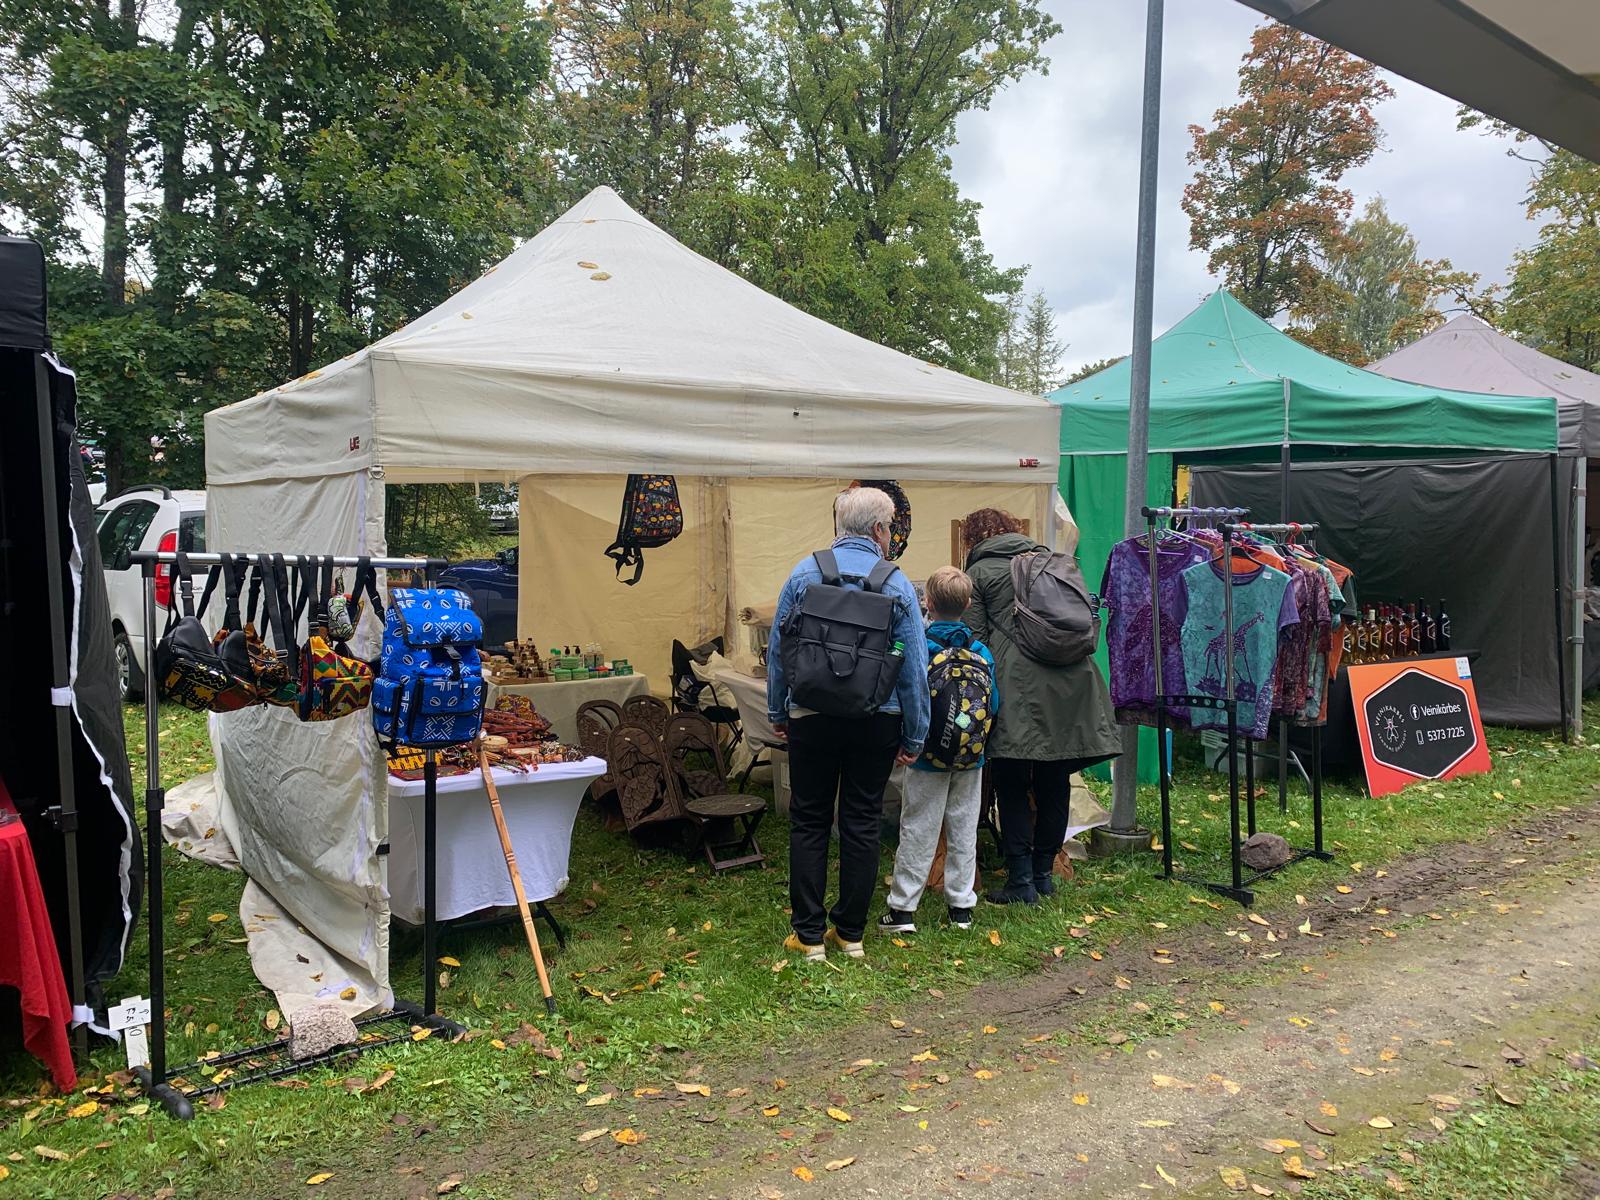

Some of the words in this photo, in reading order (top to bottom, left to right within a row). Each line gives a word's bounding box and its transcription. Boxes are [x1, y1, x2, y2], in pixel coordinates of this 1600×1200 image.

[940, 695, 957, 749] EXPLORE
[1427, 729, 1446, 741] 5373
[1446, 726, 1465, 738] 7225
